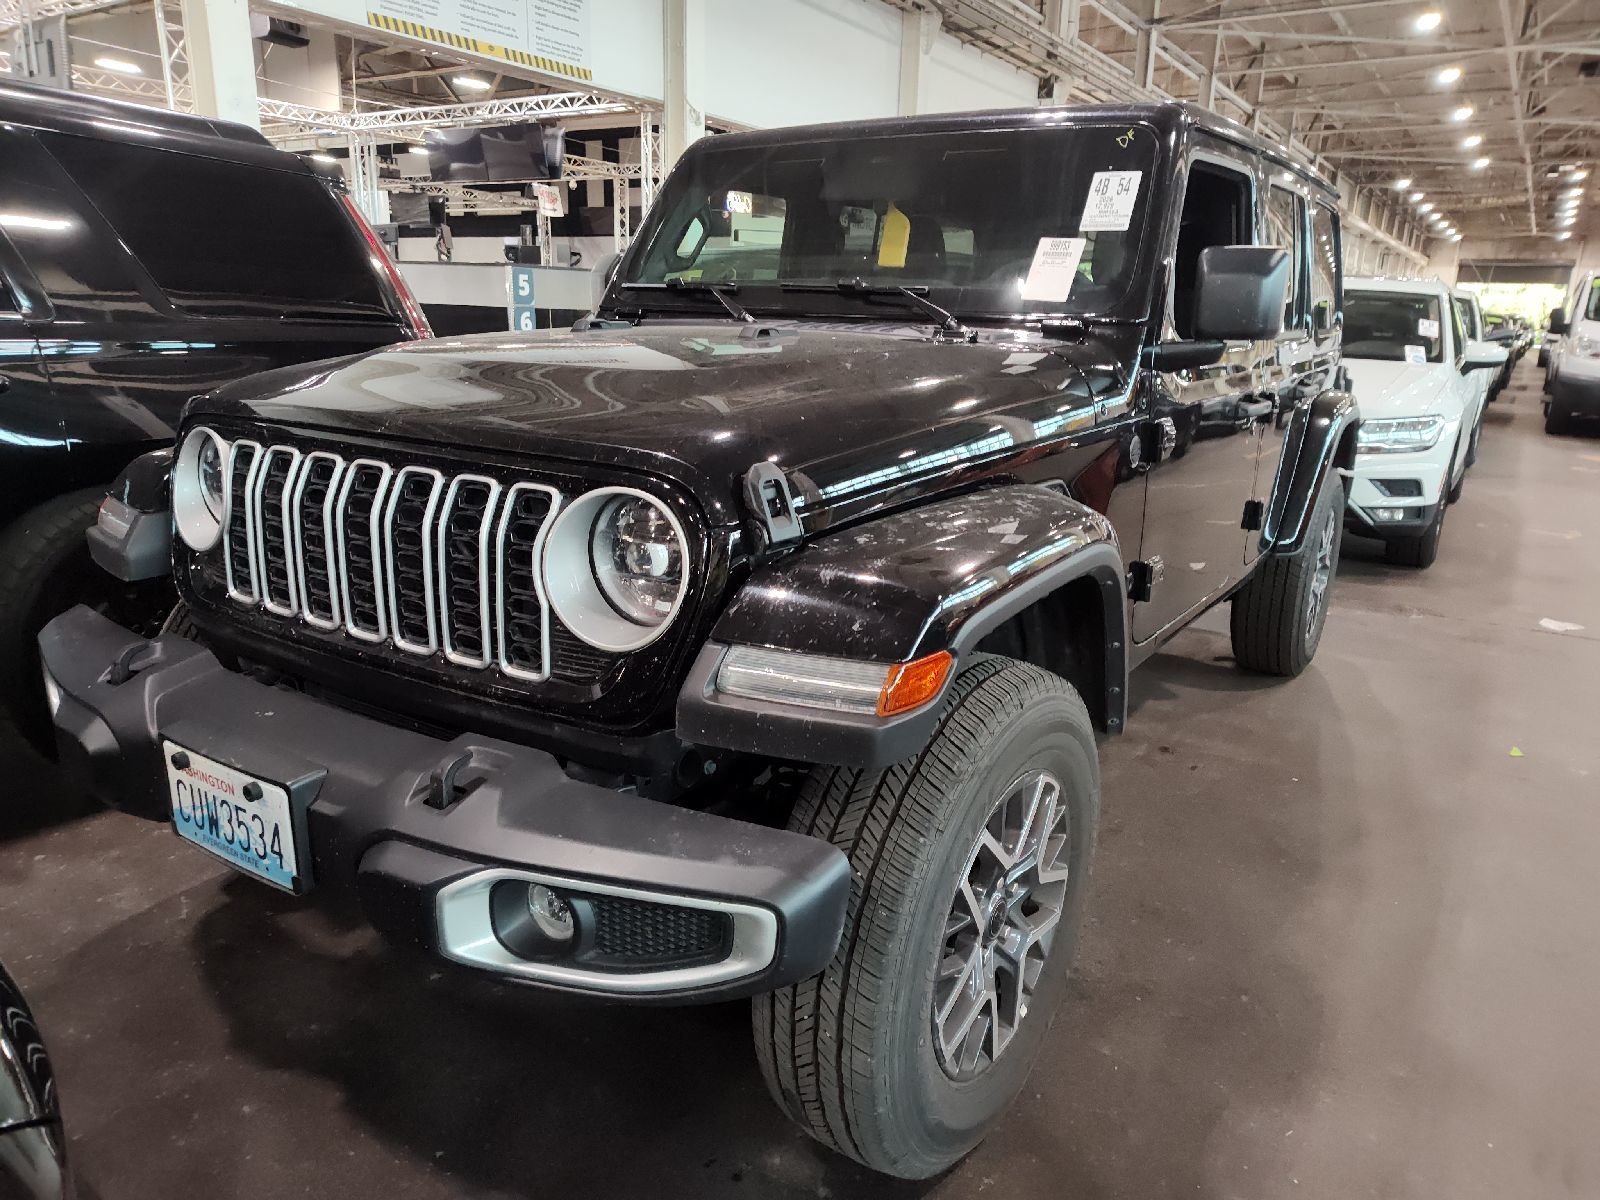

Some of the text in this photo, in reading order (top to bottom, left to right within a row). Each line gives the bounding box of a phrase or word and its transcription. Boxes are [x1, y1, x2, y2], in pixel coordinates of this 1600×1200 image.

[1094, 176, 1133, 196] 4B 54
[518, 274, 530, 297] 5
[520, 311, 532, 331] 6
[181, 766, 235, 796] ASHINGTON
[176, 779, 284, 869] CUW3534
[202, 833, 260, 868] EVERGREEN STATE
